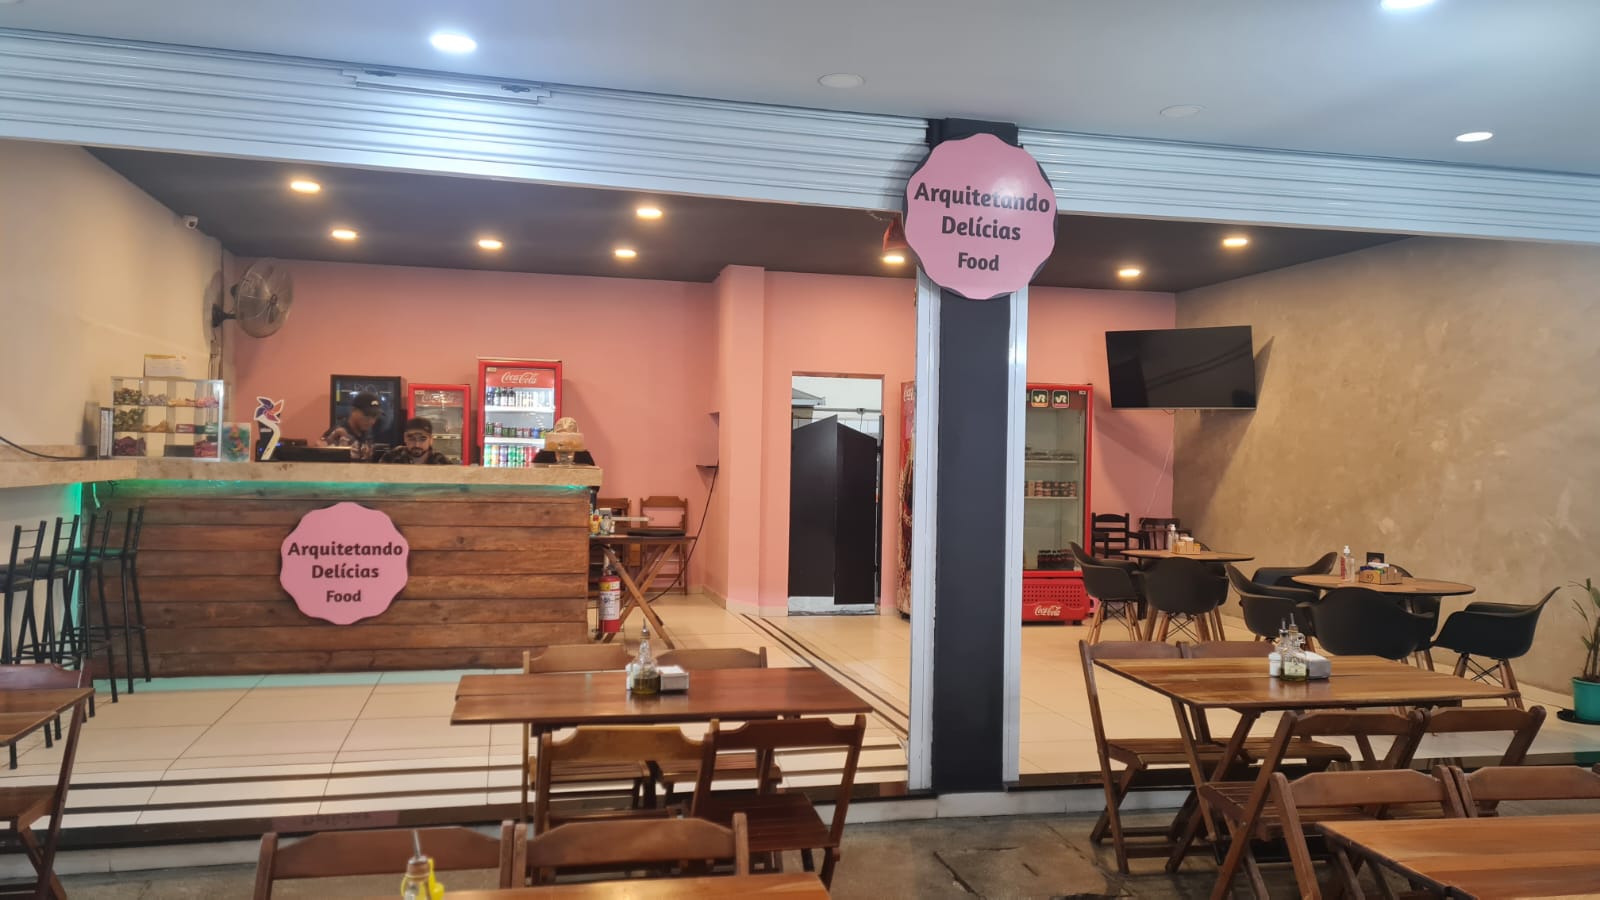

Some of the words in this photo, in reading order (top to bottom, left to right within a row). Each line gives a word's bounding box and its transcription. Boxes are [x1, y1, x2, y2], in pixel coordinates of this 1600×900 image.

[914, 182, 1050, 213] Arquitetando
[941, 215, 1021, 241] Delícias
[958, 252, 999, 272] Food
[288, 541, 403, 560] Arquitetando
[312, 563, 379, 579] Delícias
[326, 590, 361, 602] Food
